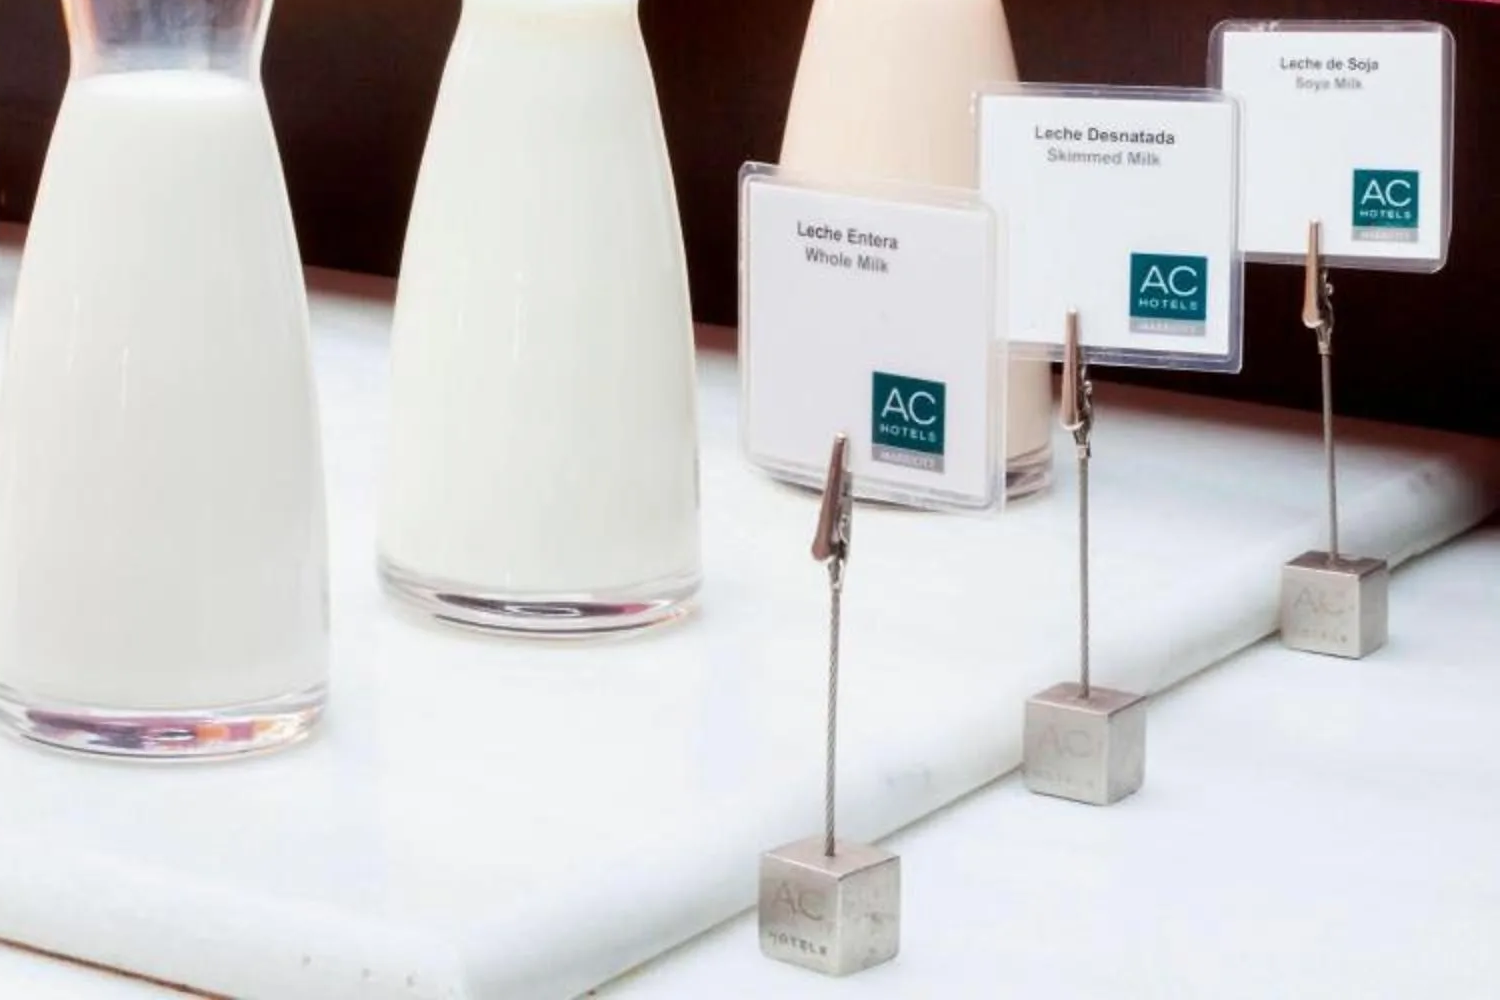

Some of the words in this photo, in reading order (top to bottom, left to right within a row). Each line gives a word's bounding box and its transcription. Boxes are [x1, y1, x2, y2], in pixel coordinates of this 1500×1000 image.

[1280, 56, 1323, 71] Leche
[1325, 57, 1344, 71] de
[1347, 56, 1380, 74] Soja
[1334, 76, 1364, 90] Milk
[1034, 126, 1083, 142] Leche
[1087, 127, 1176, 146] Desnatada
[1046, 147, 1123, 165] Skimmed
[1127, 151, 1162, 167] Milk
[1361, 178, 1413, 208] AC
[1359, 208, 1413, 221] HOTELS
[796, 219, 843, 242] Leche
[846, 227, 899, 251] Entera
[804, 245, 854, 270] Whole
[856, 253, 890, 274] Milk
[1139, 265, 1199, 298] AC
[1137, 297, 1199, 312] HOTELS
[880, 386, 937, 426] AC
[879, 422, 938, 444] HOTELS
[770, 880, 824, 922] AC
